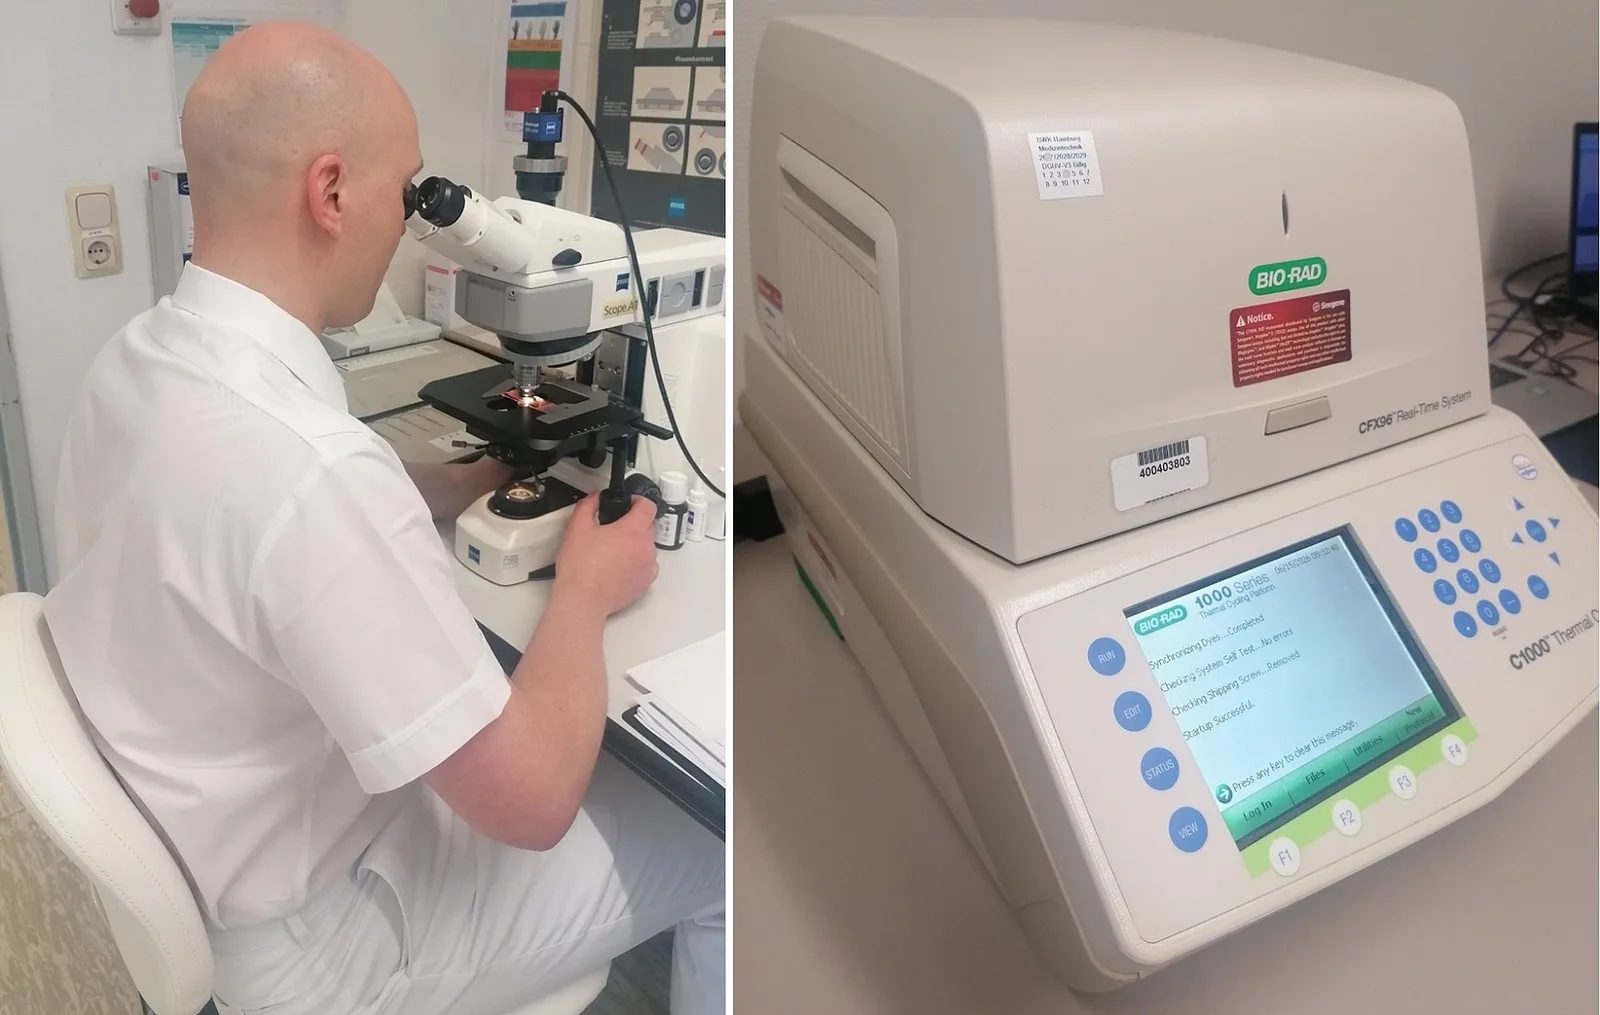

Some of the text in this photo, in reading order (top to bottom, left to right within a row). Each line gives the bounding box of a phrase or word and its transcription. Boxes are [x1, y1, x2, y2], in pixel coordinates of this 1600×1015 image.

[1256, 264, 1322, 289] BIO-RAD
[1247, 312, 1274, 324] Notice.
[1396, 400, 1440, 422] Real-Time
[1441, 391, 1472, 409] System
[1139, 456, 1191, 479] 400403803
[1402, 505, 1454, 532] 1 2 3
[1421, 535, 1473, 562] 4 5 6
[1195, 572, 1270, 609] 1000 Series
[1440, 563, 1492, 594] 7 8 9
[1199, 582, 1275, 620] Thermal Cycling Platform
[1484, 607, 1493, 617] 0
[1139, 608, 1184, 633] BIO-RAD
[1550, 614, 1594, 646] Thermal
[1098, 650, 1116, 664] RUN
[1149, 642, 1202, 670] Synchronizing
[1160, 672, 1196, 693] Checking
[1196, 660, 1224, 677] System
[1223, 651, 1238, 664] Self
[1272, 628, 1294, 641] errors
[1171, 695, 1208, 716] Checking
[1207, 679, 1240, 700] Shipping
[1124, 704, 1141, 719] EDIT
[1182, 700, 1255, 740] Startup Successful.
[1405, 706, 1422, 718] New
[1232, 720, 1358, 792] Press any key to clear this message.
[1353, 736, 1383, 756] Utilities
[1448, 743, 1461, 758] F4
[1145, 758, 1174, 780] STATUS
[1305, 768, 1326, 784] Files
[1397, 775, 1411, 790] F3
[1242, 799, 1273, 823] Log In
[1340, 810, 1355, 825] F2
[1178, 822, 1198, 840] VIEW
[1278, 849, 1293, 865] F1
